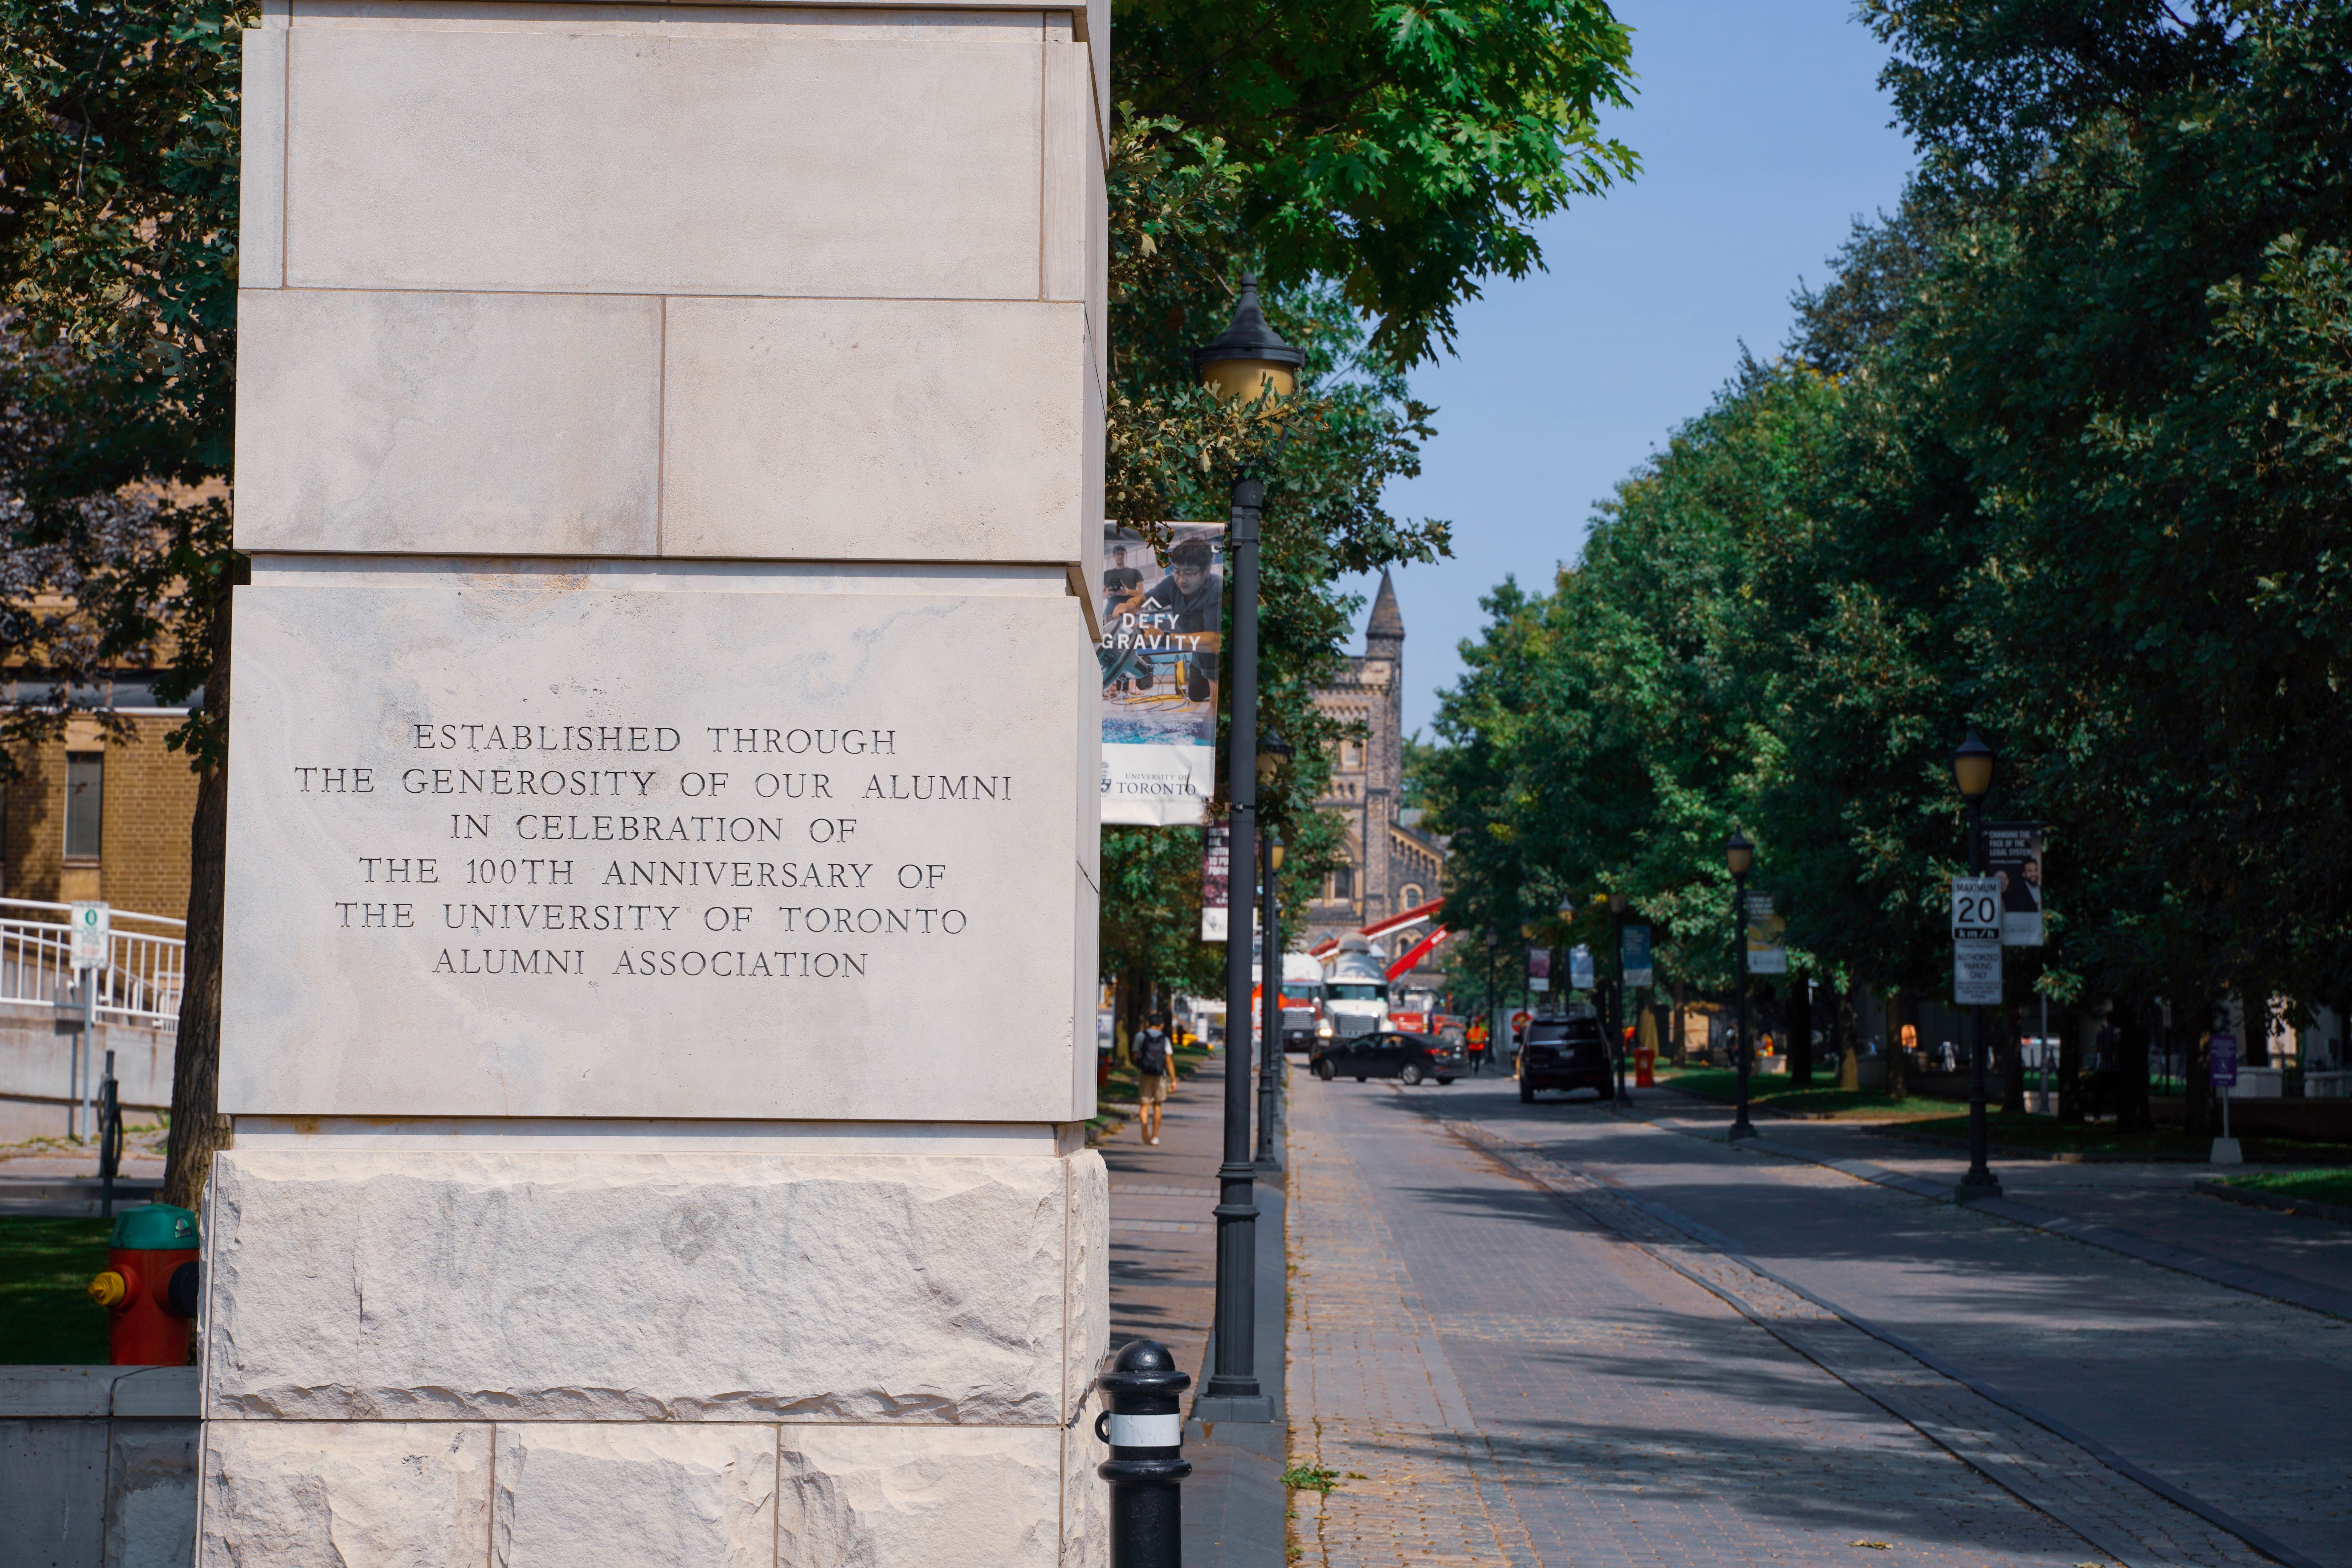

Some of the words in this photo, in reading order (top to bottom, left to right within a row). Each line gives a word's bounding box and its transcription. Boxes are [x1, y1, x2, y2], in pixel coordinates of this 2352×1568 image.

[1123, 613, 1179, 629] DEFY
[1101, 633, 1200, 651] GRAVITY
[414, 724, 680, 751] ESTABLISHED
[707, 727, 895, 754] THROUGH
[294, 767, 374, 792] THE
[401, 769, 656, 796] GENEROSITY
[680, 772, 728, 796] OF
[755, 773, 833, 798] OUR
[862, 774, 1011, 800] ALUMNI
[1116, 782, 1196, 795] TORONTO
[450, 814, 491, 838] IN
[516, 815, 783, 842] CELEBRATION
[810, 818, 856, 843] OF
[1989, 839, 2004, 848] FACE
[2005, 839, 2013, 848] OF
[2015, 839, 2025, 848] THE
[1989, 848, 2007, 857] LEGAL
[2009, 848, 2032, 857] SYSTEM
[359, 857, 438, 883] THE
[467, 859, 573, 884] 100TH
[602, 861, 873, 887] ANNIVERSARY
[898, 864, 945, 889] OF
[335, 902, 414, 927] THE
[443, 904, 680, 930] UNIVERSITY
[704, 907, 752, 931] OF
[779, 907, 966, 934] TORONTO
[1959, 898, 1994, 922] 20
[1959, 929, 1994, 938] km/h
[432, 948, 584, 974] ALUMNI
[612, 950, 867, 977] ASSOCIATION
